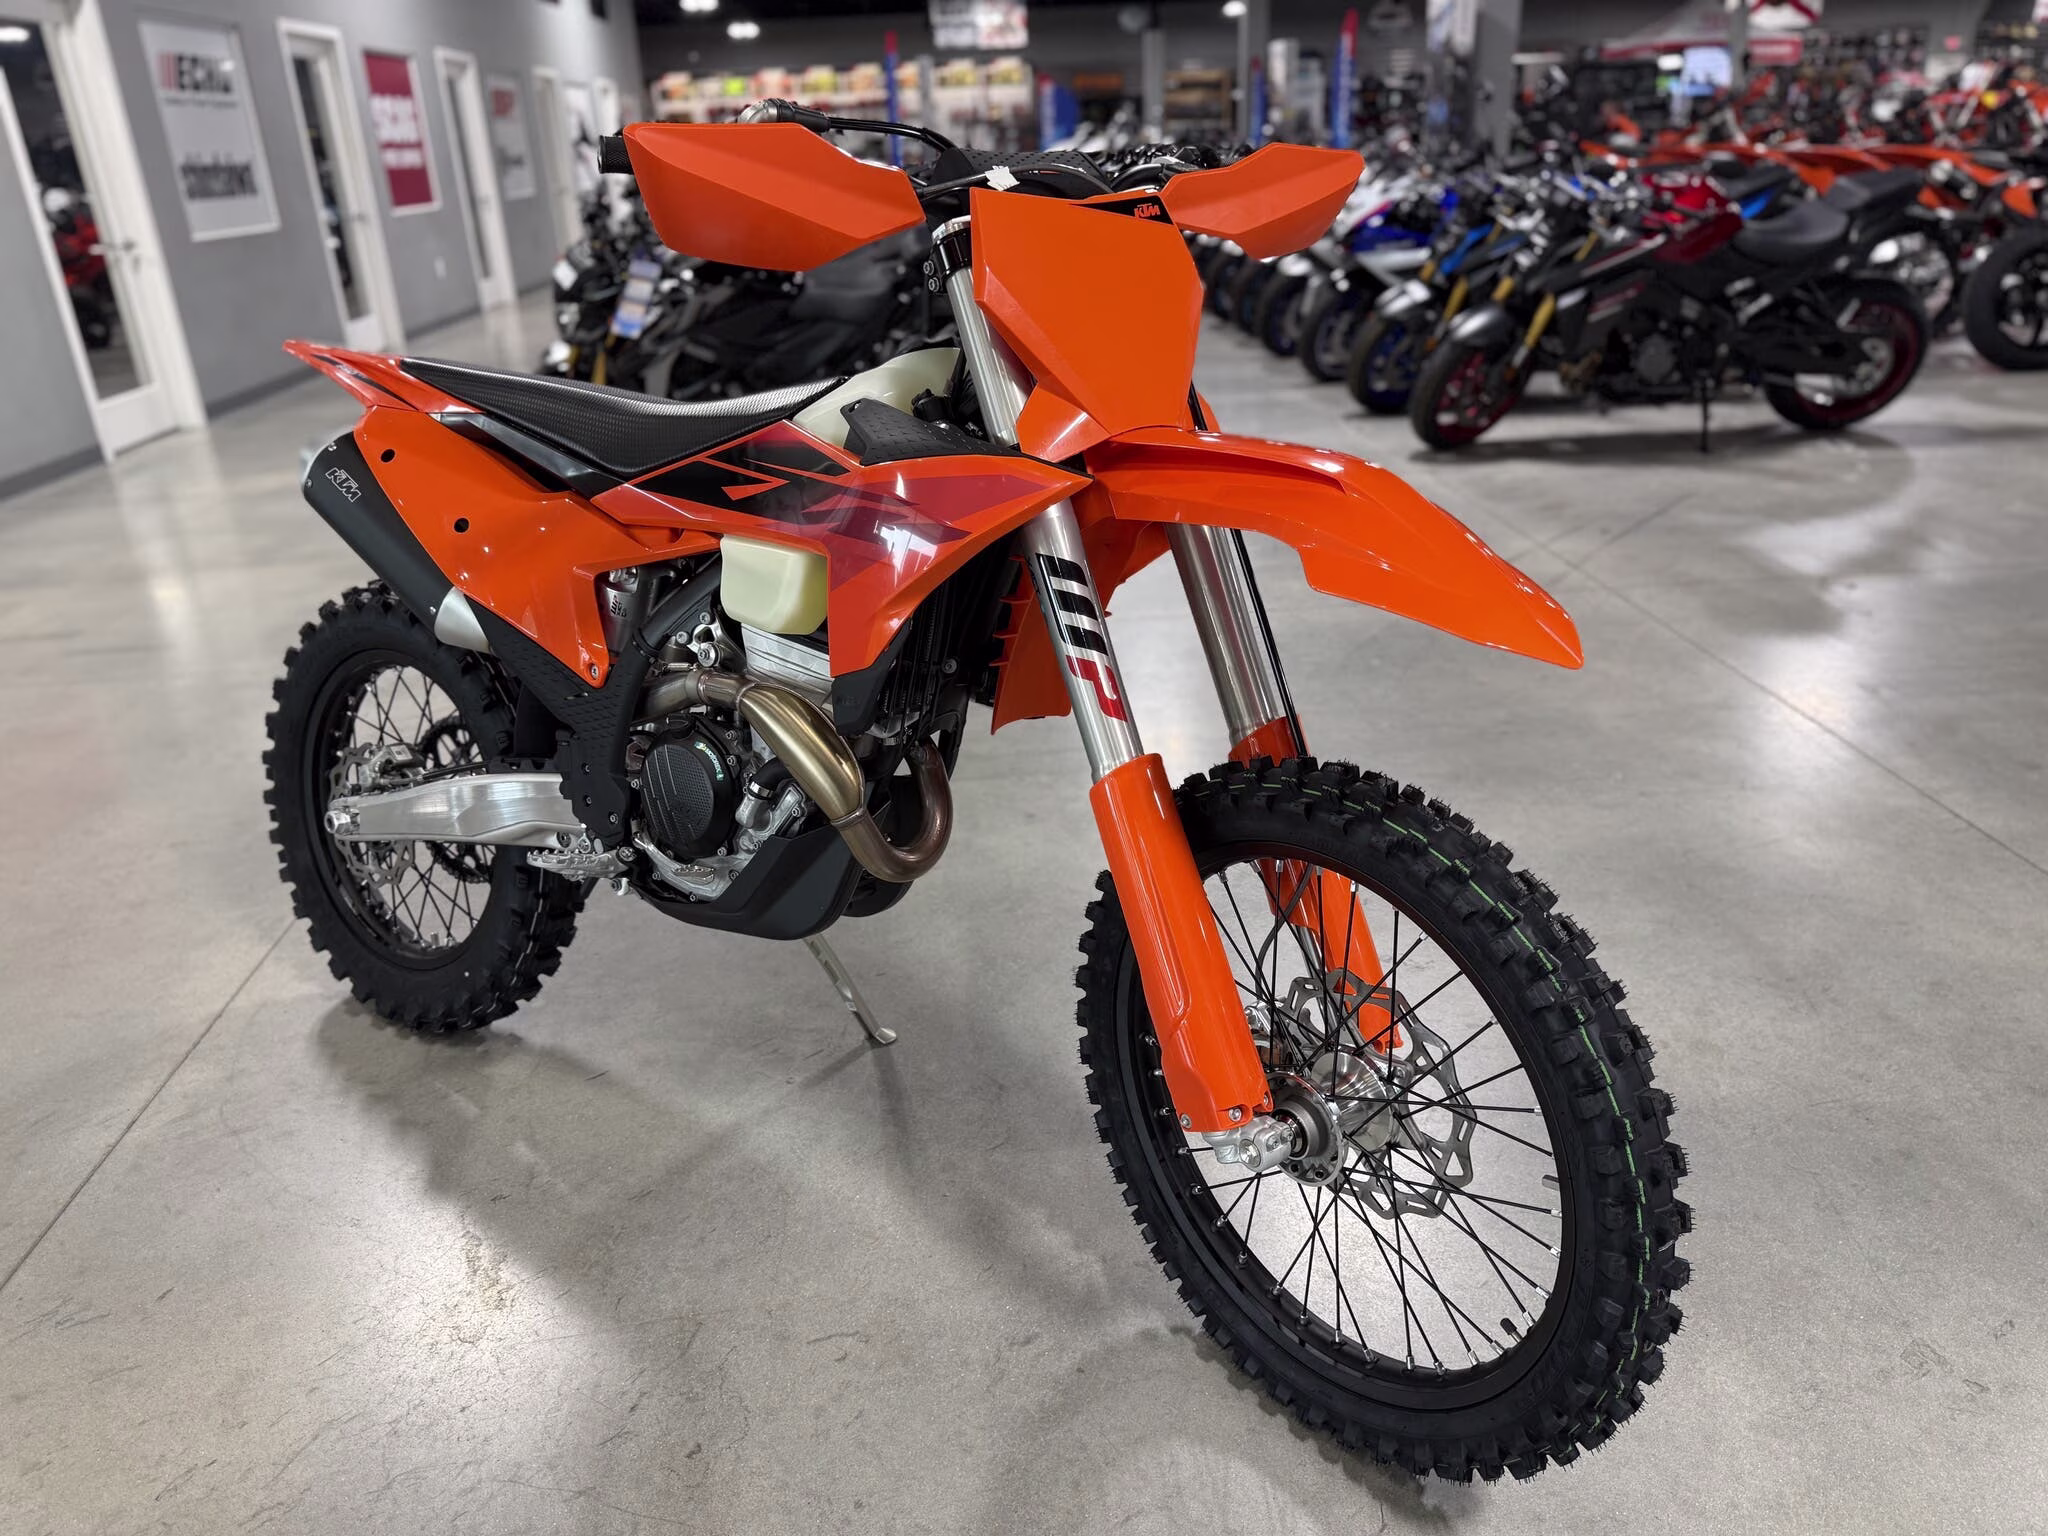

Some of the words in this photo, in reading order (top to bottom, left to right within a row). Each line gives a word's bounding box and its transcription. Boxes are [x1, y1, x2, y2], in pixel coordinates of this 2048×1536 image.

[1134, 203, 1160, 218] KTM
[325, 467, 361, 502] KTM
[1035, 552, 1128, 722] WP
